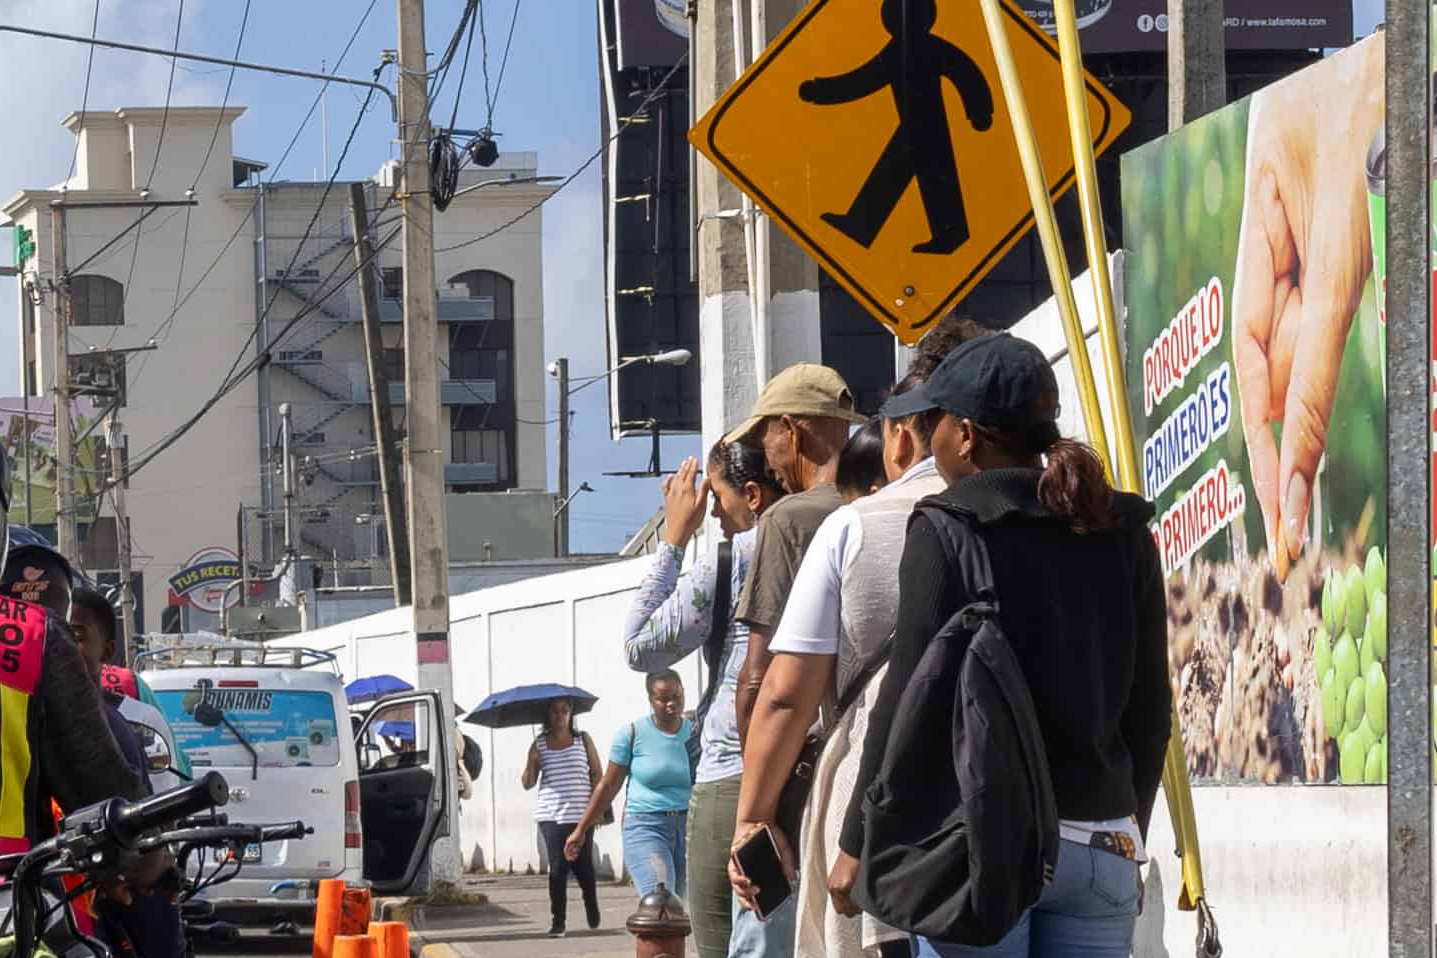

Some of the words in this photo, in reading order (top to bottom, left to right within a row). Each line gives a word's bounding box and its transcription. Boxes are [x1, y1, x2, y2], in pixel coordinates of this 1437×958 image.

[1145, 303, 1199, 410] PORQUE
[1201, 283, 1222, 347] LO
[1145, 390, 1209, 498] PRIMERO
[1210, 369, 1230, 433] ES
[177, 571, 200, 588] TUS
